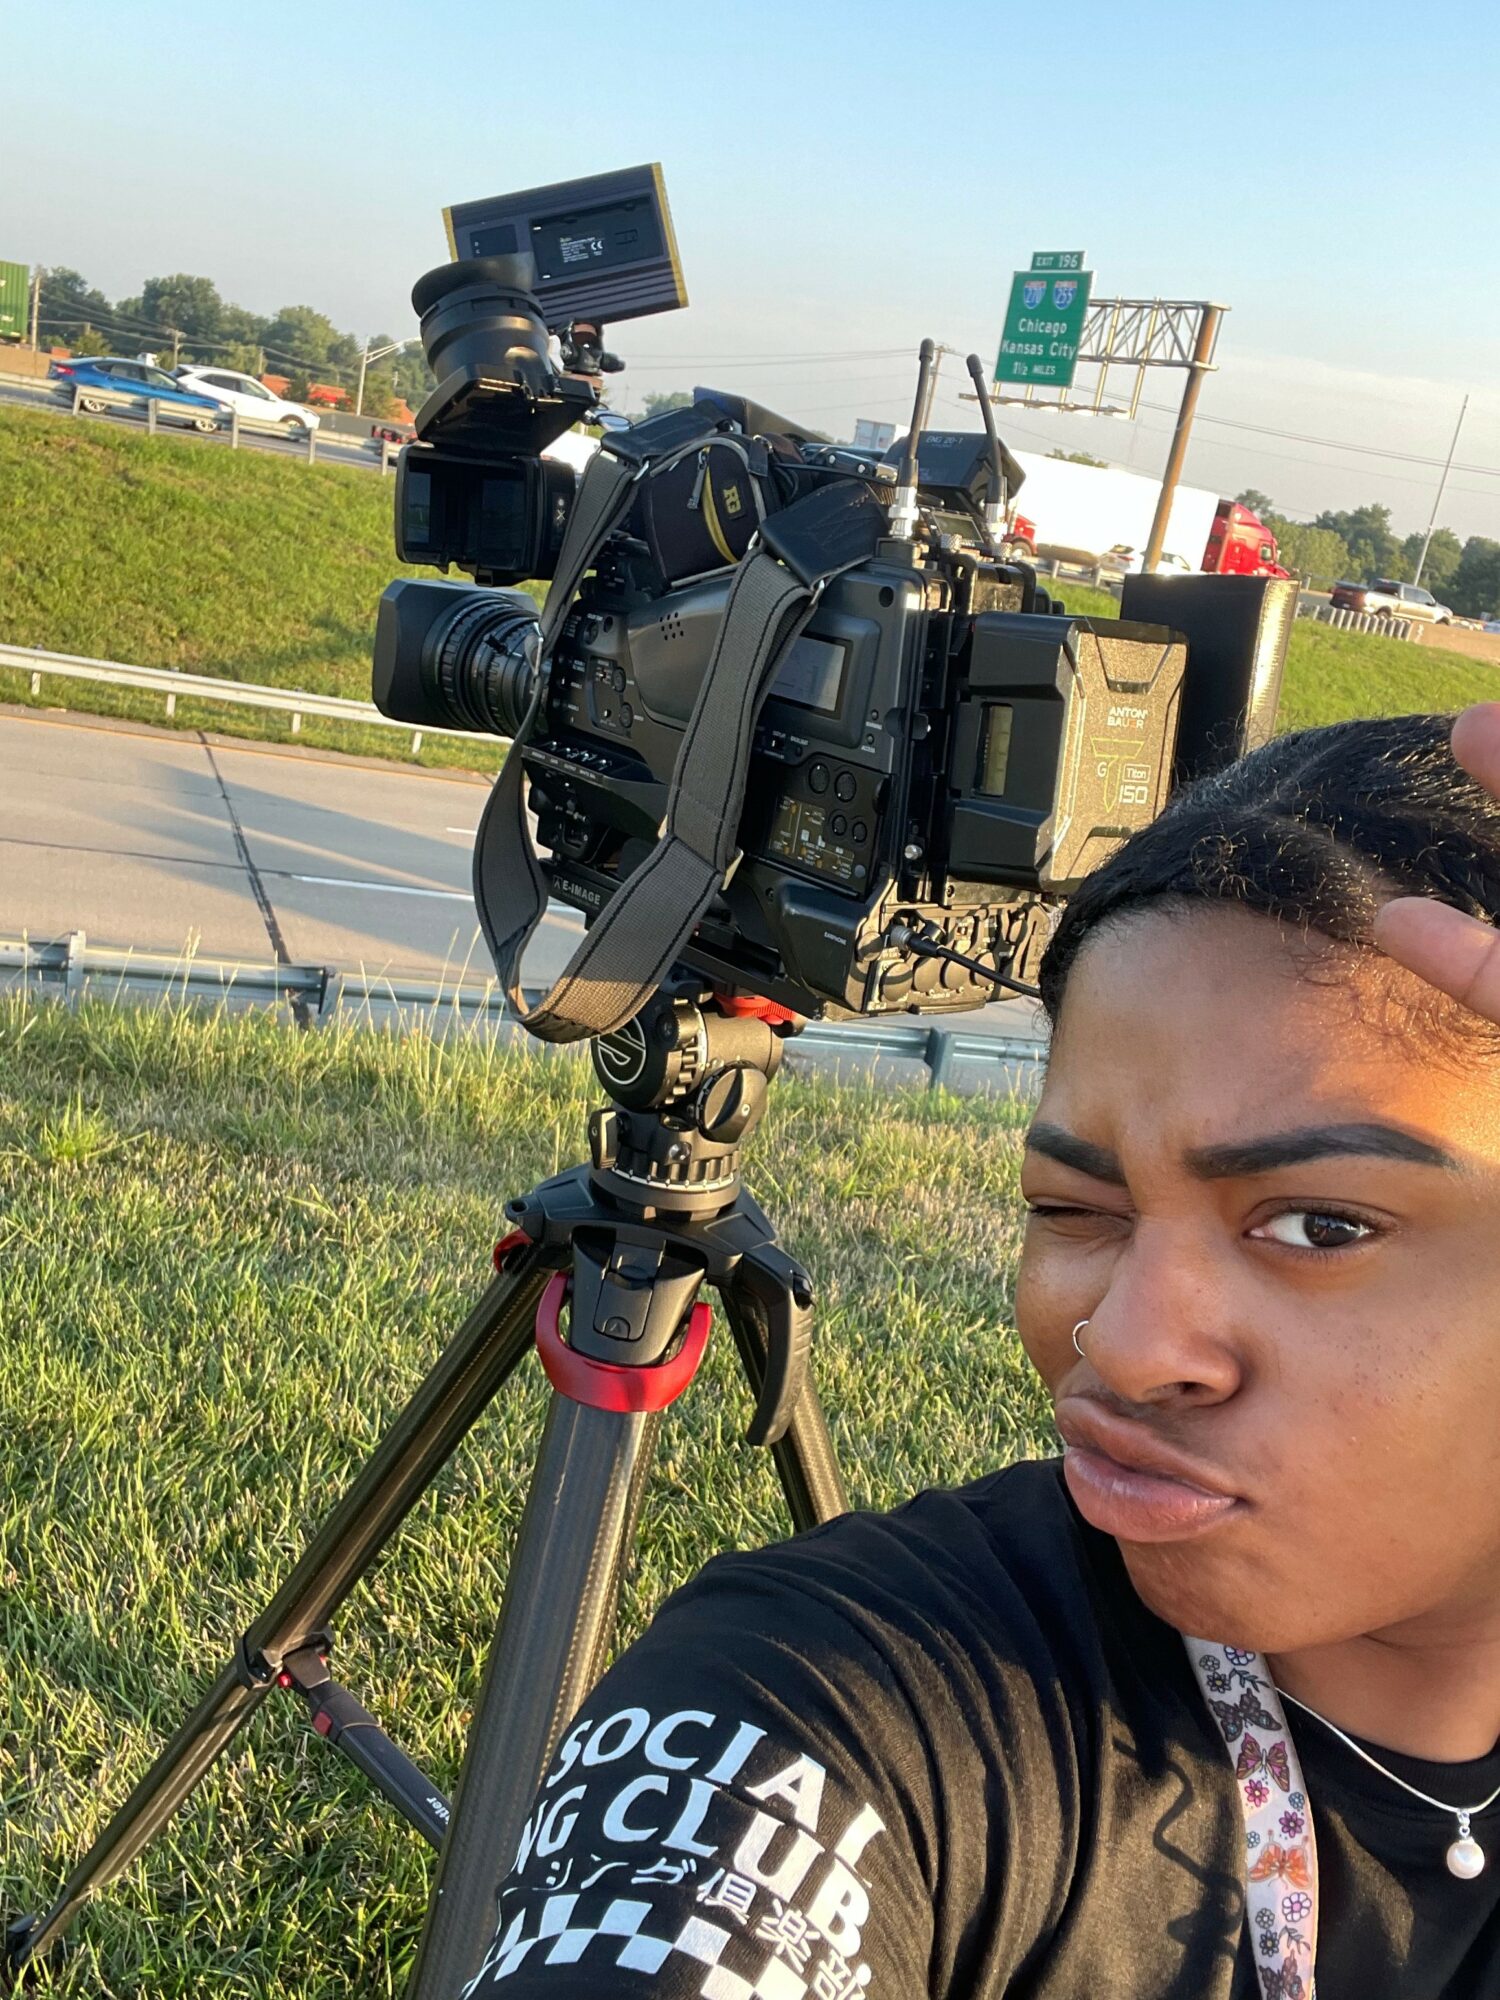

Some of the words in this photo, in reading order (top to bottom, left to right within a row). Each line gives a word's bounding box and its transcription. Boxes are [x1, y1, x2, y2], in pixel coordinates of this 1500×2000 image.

[1036, 256, 1053, 267] EXIT
[1058, 255, 1078, 268] 196
[1055, 288, 1073, 304] 255
[1019, 318, 1067, 337] Chicago
[1001, 340, 1044, 355] Kansas
[1050, 342, 1077, 360] City
[1032, 365, 1056, 376] MILES
[1109, 707, 1148, 719] ANTON
[1097, 761, 1107, 778] G
[1119, 785, 1148, 804] 150
[562, 879, 601, 905] E-IMAGE
[546, 1706, 887, 1888] SOCIAL
[602, 1774, 870, 1958] CLUB
